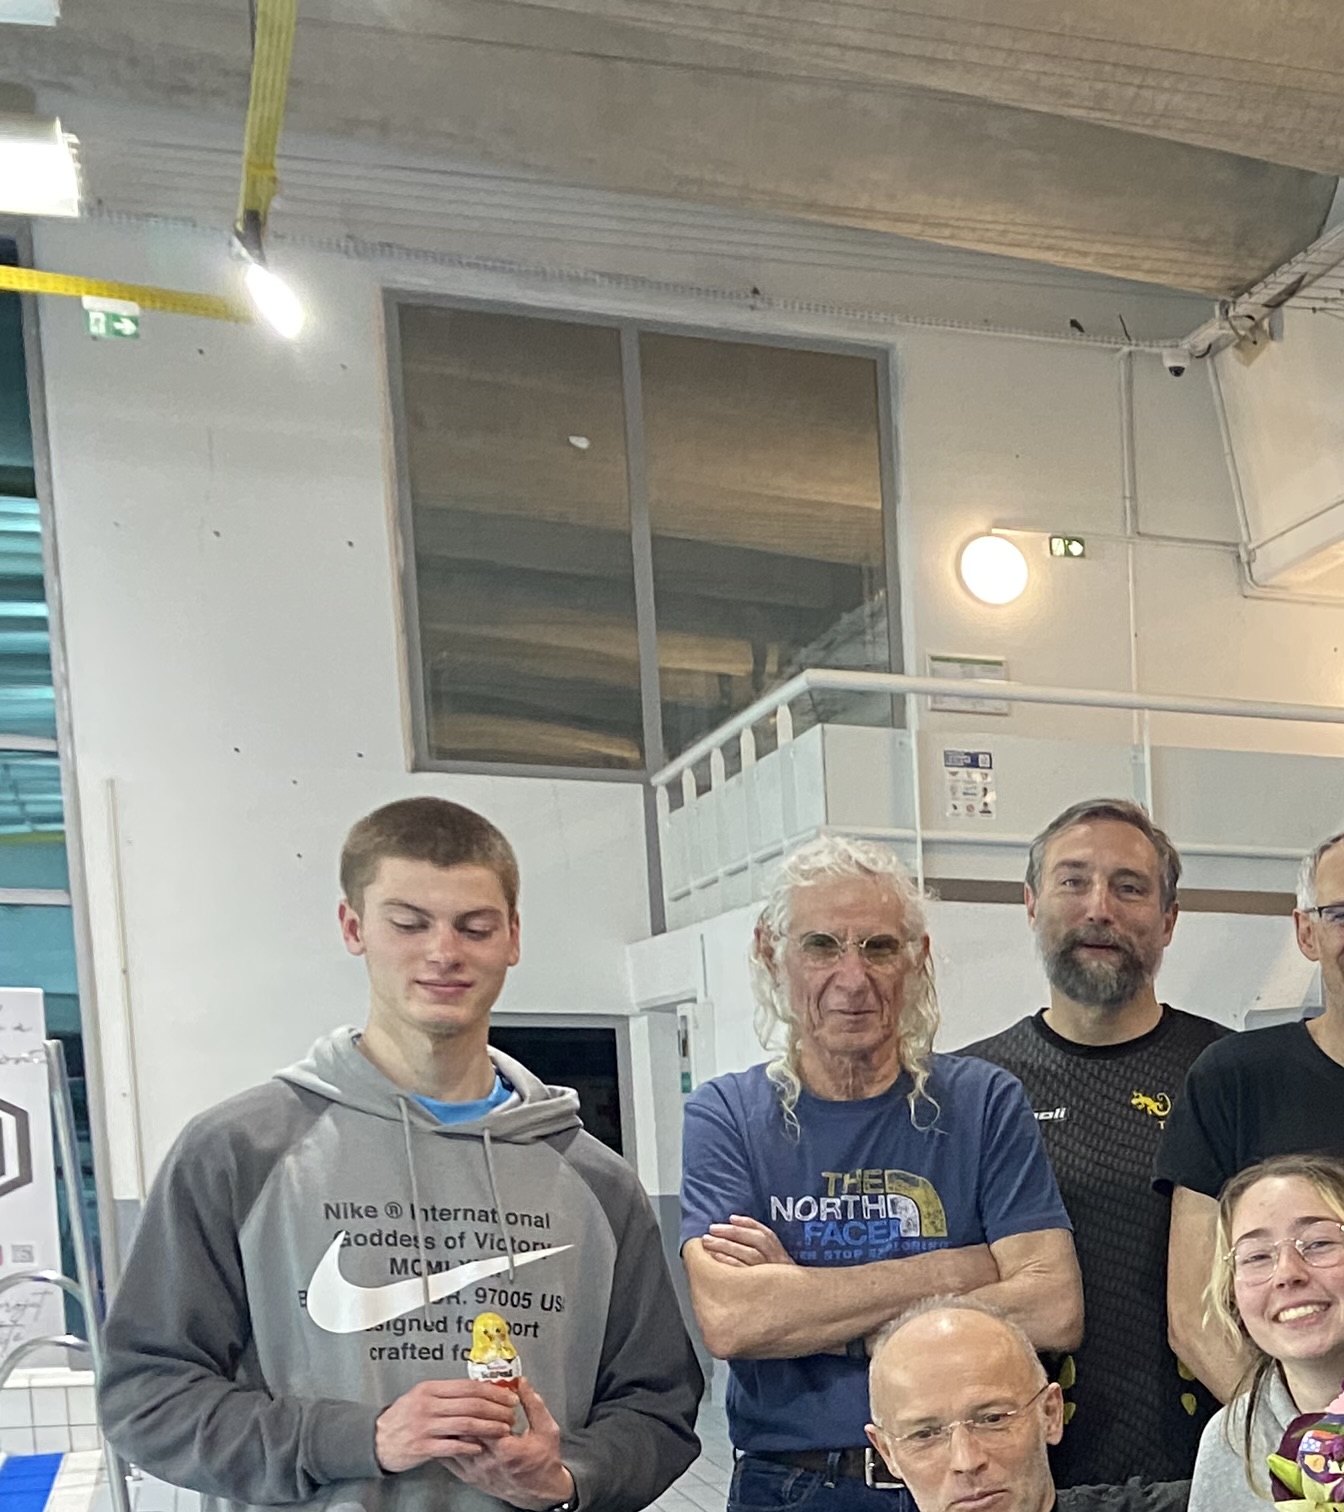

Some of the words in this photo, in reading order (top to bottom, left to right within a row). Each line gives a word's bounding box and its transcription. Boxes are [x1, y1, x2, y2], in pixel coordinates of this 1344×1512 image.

[821, 1168, 885, 1196] THE
[323, 1202, 379, 1220] Nike
[410, 1203, 552, 1229] Internatonal
[769, 1194, 887, 1222] NORTH
[444, 1231, 466, 1250] of
[804, 1220, 890, 1247] FACE
[823, 1250, 863, 1261] STOP
[475, 1287, 533, 1310] 97005
[540, 1293, 565, 1312] US
[364, 1316, 448, 1336] signed
[456, 1316, 474, 1334] fo
[507, 1321, 540, 1338] port
[370, 1343, 444, 1361] crafted
[452, 1344, 471, 1361] fo
